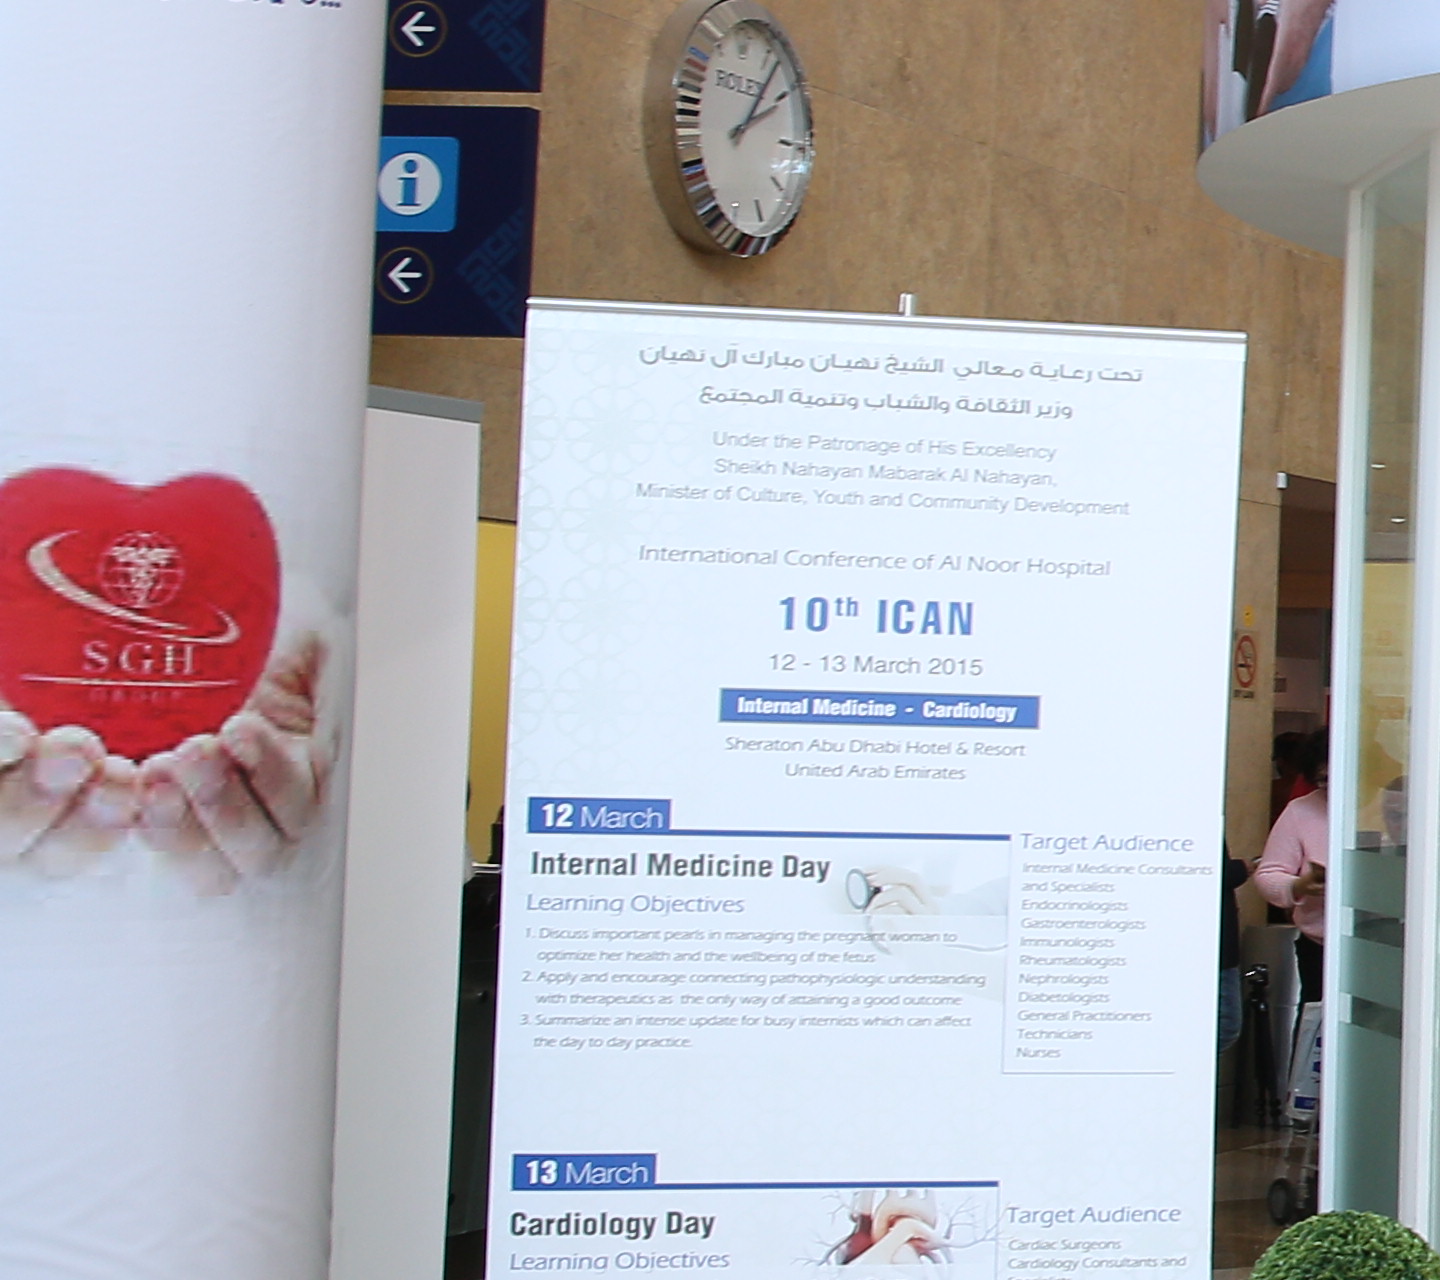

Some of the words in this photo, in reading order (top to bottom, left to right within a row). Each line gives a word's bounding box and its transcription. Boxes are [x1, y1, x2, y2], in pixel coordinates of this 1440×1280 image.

[639, 545, 779, 568] International
[783, 549, 907, 570] Conference
[912, 553, 935, 571] of
[967, 555, 1021, 574] Noor
[1027, 557, 1111, 579] Hospital
[779, 595, 860, 633] 10th
[876, 599, 974, 636] ICAN
[82, 640, 197, 676] SGH
[769, 654, 796, 672] 12
[820, 655, 847, 672] 13
[853, 655, 921, 675] March
[927, 658, 984, 677] 2015
[737, 696, 809, 715] Internal
[812, 698, 897, 718] Medicine
[922, 701, 1018, 723] Cardiology
[541, 802, 574, 828] 12
[580, 805, 664, 830] March
[1020, 833, 1089, 854] Target
[1092, 834, 1195, 852] Audience
[530, 851, 637, 876] Internal
[646, 853, 772, 878] Medicine
[782, 855, 832, 884] Day
[526, 894, 624, 915] Learning
[630, 894, 745, 915] Objectives
[526, 1159, 557, 1184] 13
[565, 1160, 650, 1185] March
[510, 1212, 657, 1240] Cardiology
[666, 1211, 716, 1239] Day
[1007, 1207, 1076, 1228] Target
[1080, 1206, 1182, 1223] Audience
[509, 1252, 609, 1272] Learning
[614, 1250, 730, 1270] Objectives
